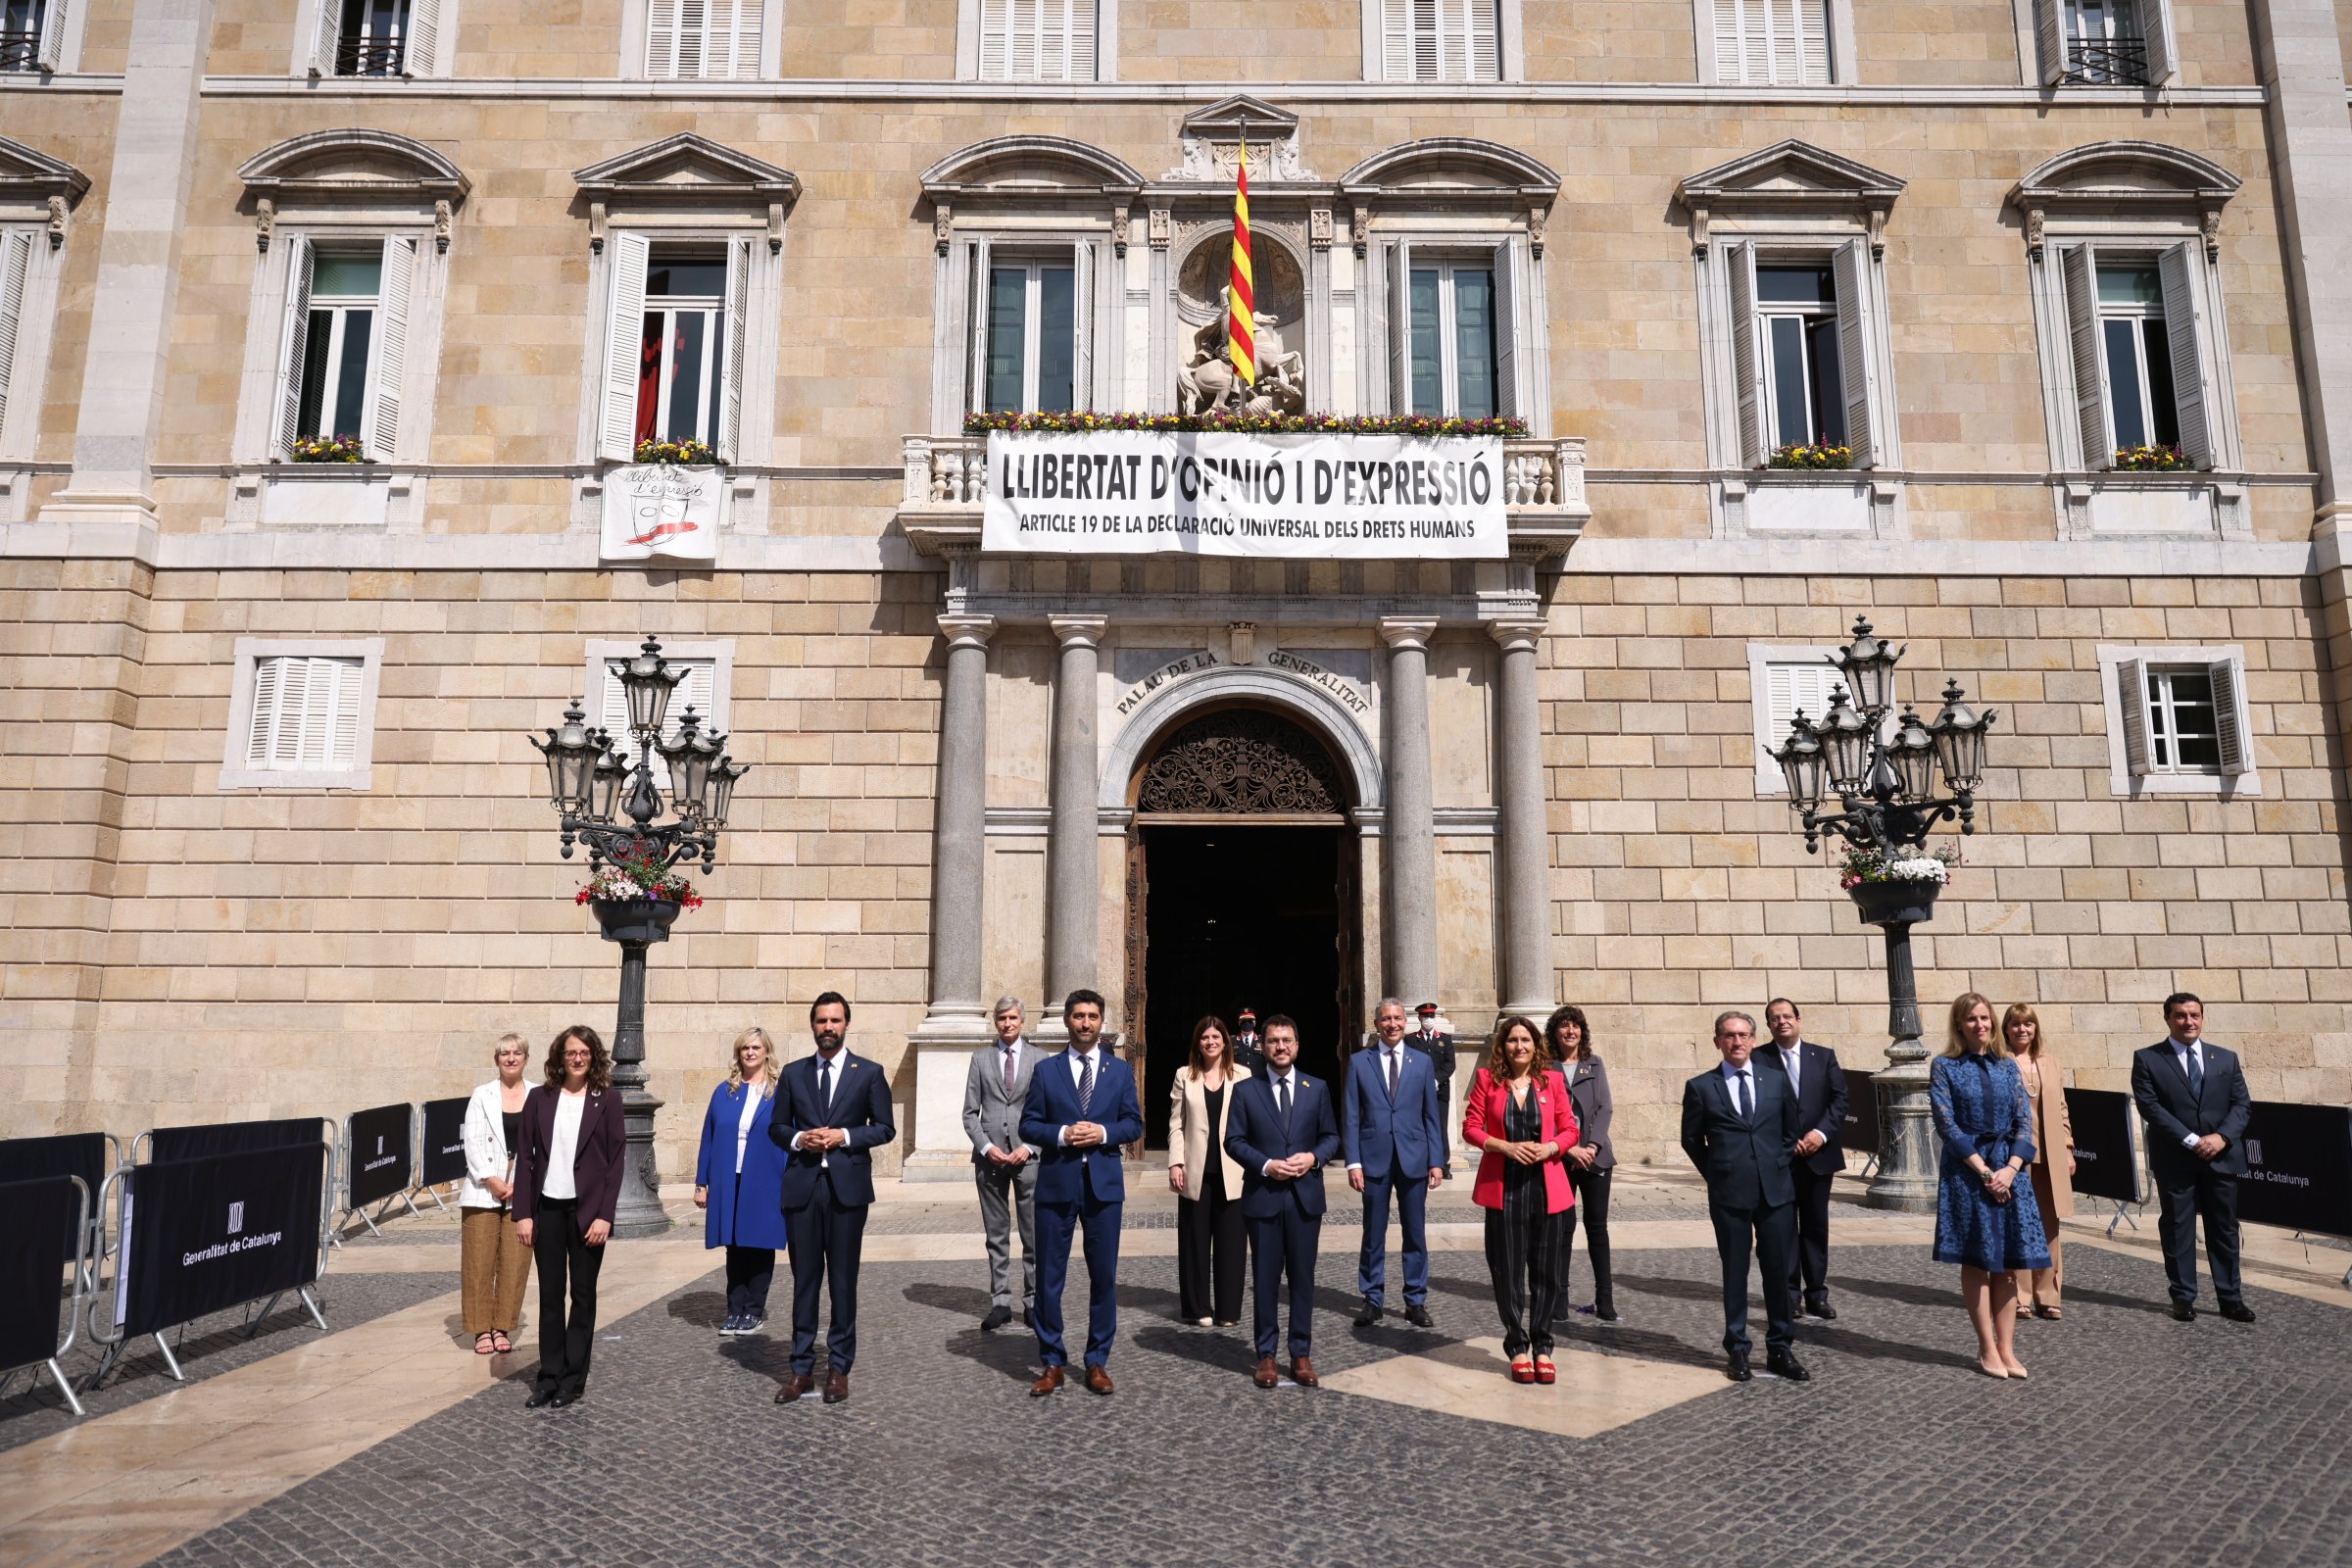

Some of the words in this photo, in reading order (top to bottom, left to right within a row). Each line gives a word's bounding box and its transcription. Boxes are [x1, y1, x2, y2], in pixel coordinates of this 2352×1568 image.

[1004, 454, 1141, 500] LLIBERTAT
[1296, 460, 1303, 505] I
[1314, 451, 1491, 507] D'EXPRESSIÓ
[1019, 514, 1076, 533] ARTICLE
[1081, 515, 1098, 533] 19
[1102, 515, 1120, 533] DE
[1125, 515, 1143, 534] LA
[1148, 513, 1235, 536] DECLARACIÓ
[1241, 518, 1320, 539] UNIVERSAL
[1324, 520, 1358, 539] DELS
[1362, 519, 1405, 539] DRETS
[1410, 519, 1475, 539] HUMANS
[1116, 671, 1164, 715] PALAU
[1166, 660, 1191, 678] DE
[1194, 653, 1218, 668] LA
[1268, 652, 1369, 713] GENERALITAT
[2253, 1169, 2265, 1181] de
[2266, 1170, 2310, 1188] Catalunya
[182, 1242, 228, 1266] Generalitat
[229, 1239, 241, 1253] de
[241, 1231, 282, 1250] Catalunya
